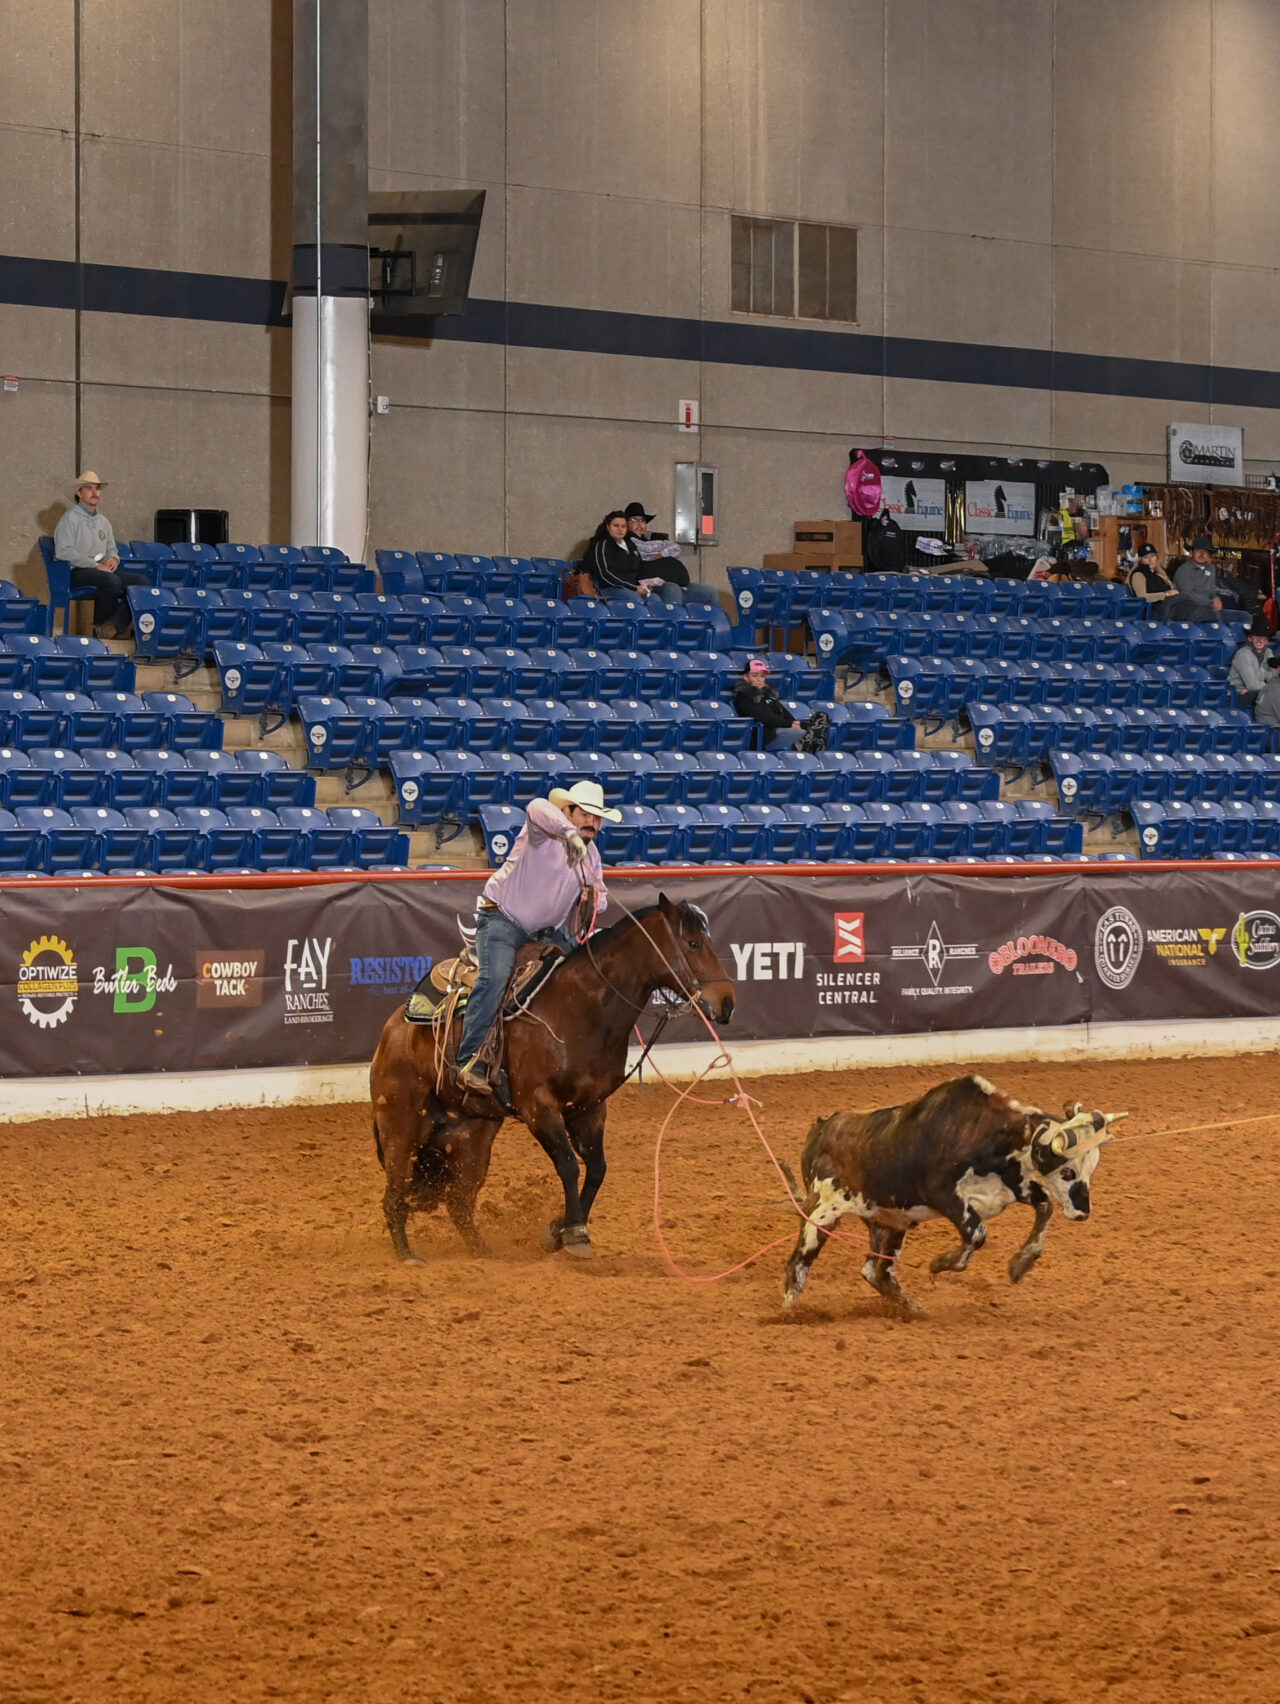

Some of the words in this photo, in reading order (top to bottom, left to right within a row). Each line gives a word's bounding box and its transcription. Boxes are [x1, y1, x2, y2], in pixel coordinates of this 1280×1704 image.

[1194, 443, 1236, 457] MARTIN
[917, 500, 943, 519] Equine
[968, 501, 993, 518] Classic
[1147, 928, 1199, 943] AMERICAN
[1156, 943, 1205, 957] NATIONAL
[202, 960, 258, 979] COWBOY
[284, 937, 332, 991] FAY
[730, 942, 804, 982] YETI
[18, 965, 78, 981] OPTIWIZE
[92, 966, 141, 995] Butler
[143, 963, 178, 993] Beds
[815, 972, 881, 987] SILENCER
[215, 979, 246, 997] TACK
[285, 992, 330, 1011] RANCHES
[818, 991, 878, 1005] CENTRAL
[284, 1015, 301, 1025] LAND
